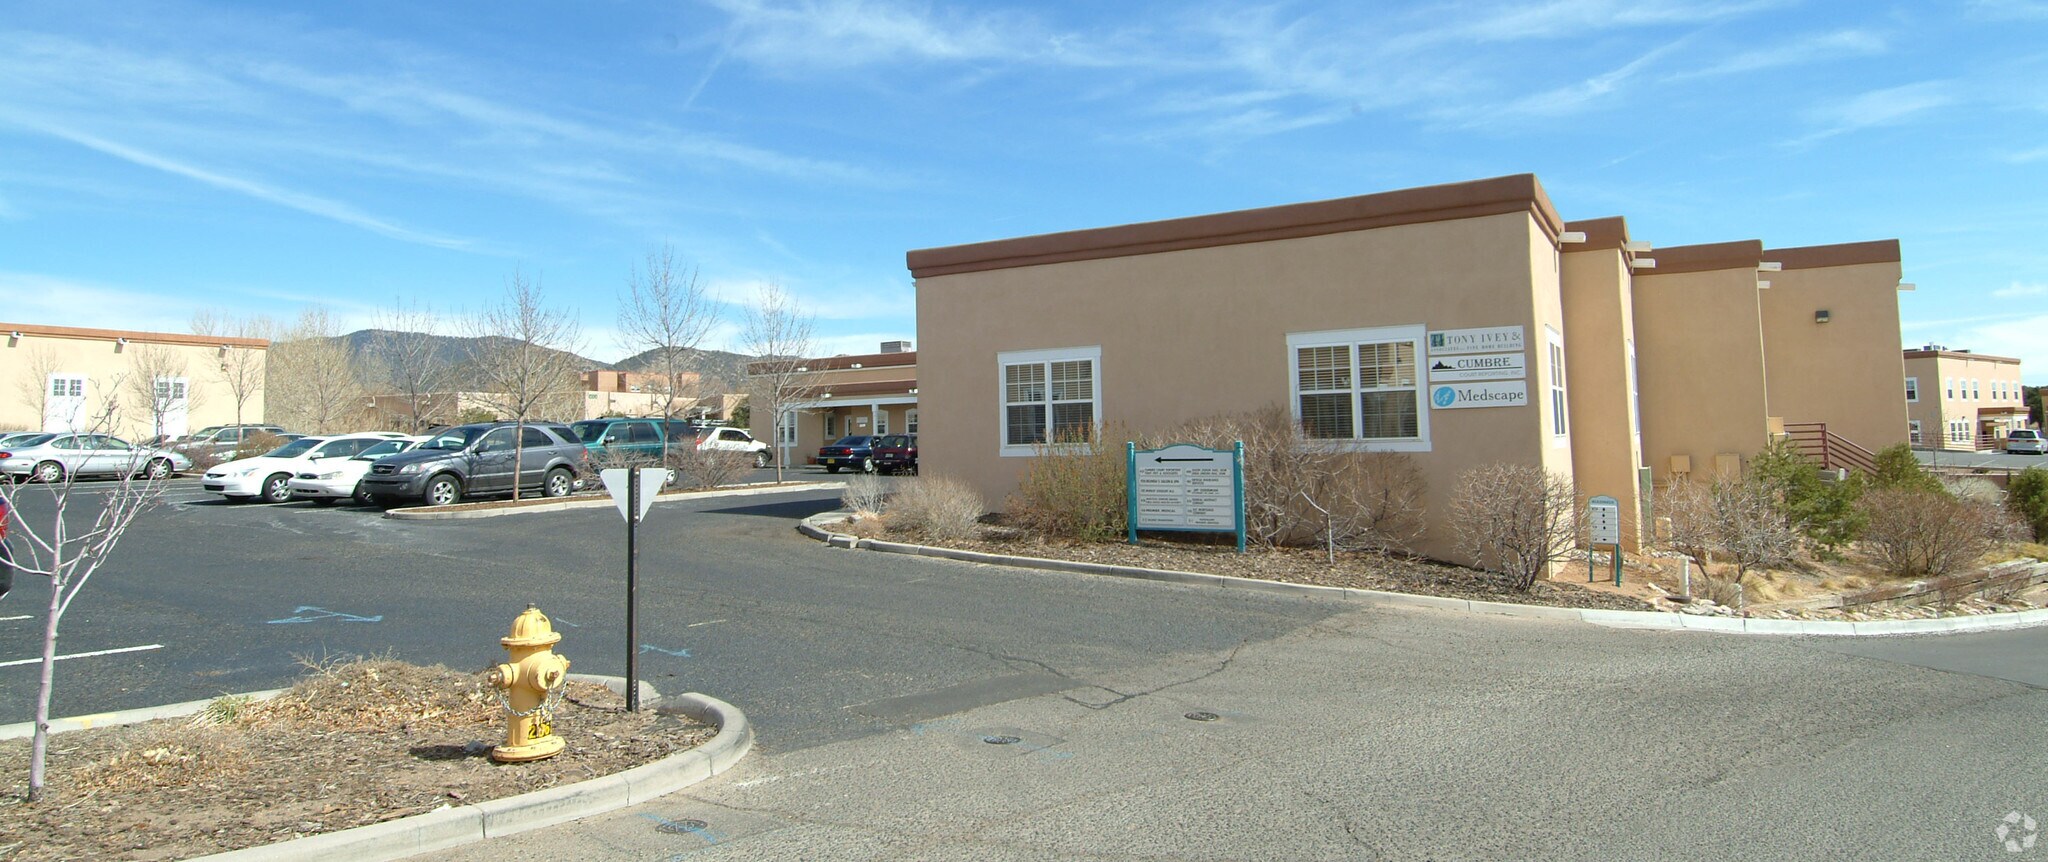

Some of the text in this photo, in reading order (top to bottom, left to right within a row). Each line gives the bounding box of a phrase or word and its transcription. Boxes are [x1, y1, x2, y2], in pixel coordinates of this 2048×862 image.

[1447, 335, 1476, 345] TONY
[1481, 333, 1508, 343] IVEY
[1511, 331, 1521, 341] &
[1457, 357, 1511, 369] CUMBRE
[1458, 389, 1524, 402] Medscape
